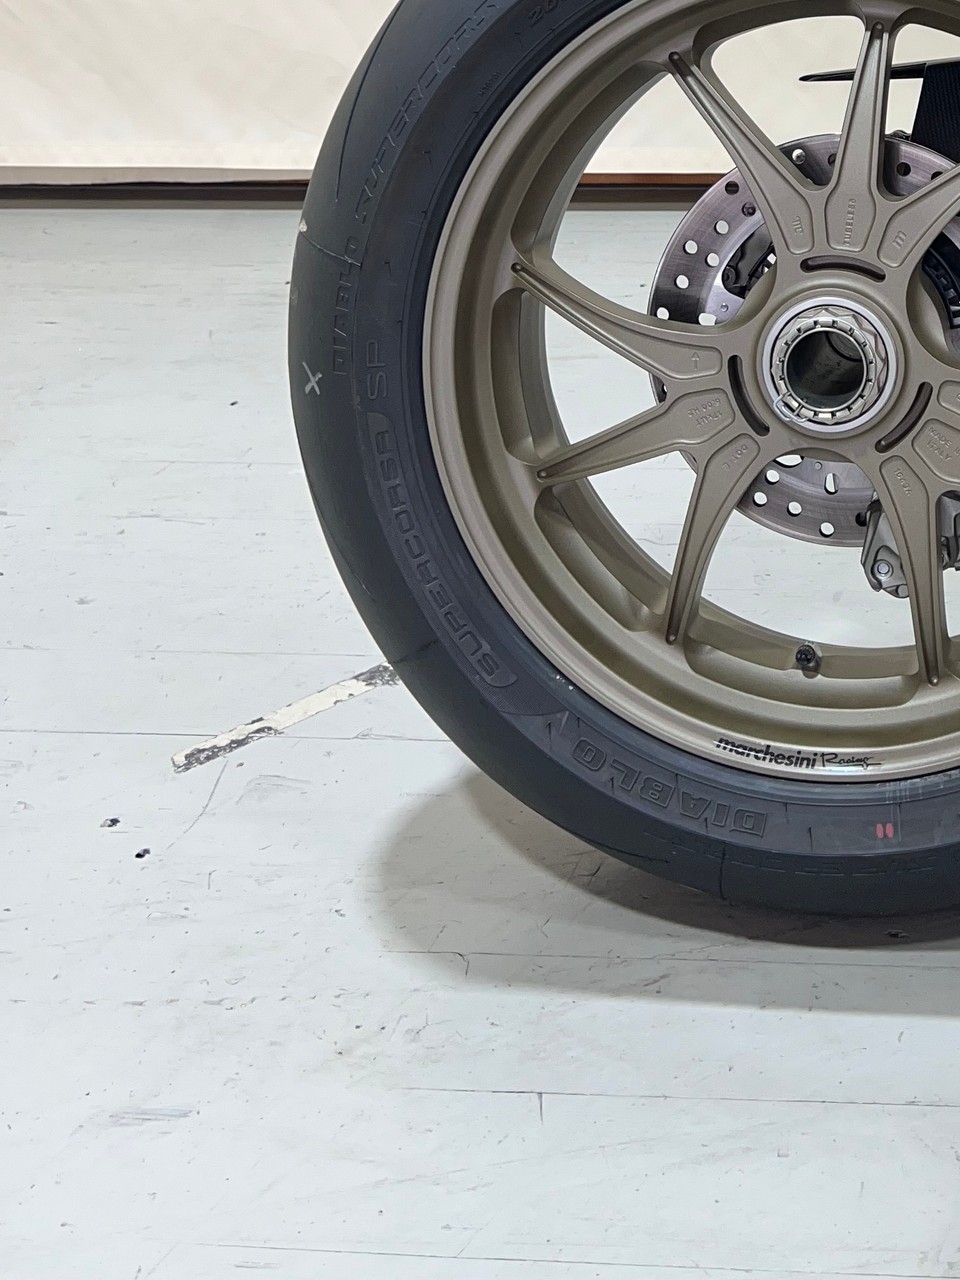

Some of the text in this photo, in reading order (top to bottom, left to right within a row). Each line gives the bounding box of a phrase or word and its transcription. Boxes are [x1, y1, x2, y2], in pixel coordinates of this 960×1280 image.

[331, 235, 365, 372] DIABLO
[926, 439, 952, 461] ITALY
[928, 426, 953, 449] MADE
[366, 340, 767, 838] DIABLO SUPERCORSA SP
[715, 737, 818, 769] marchesini
